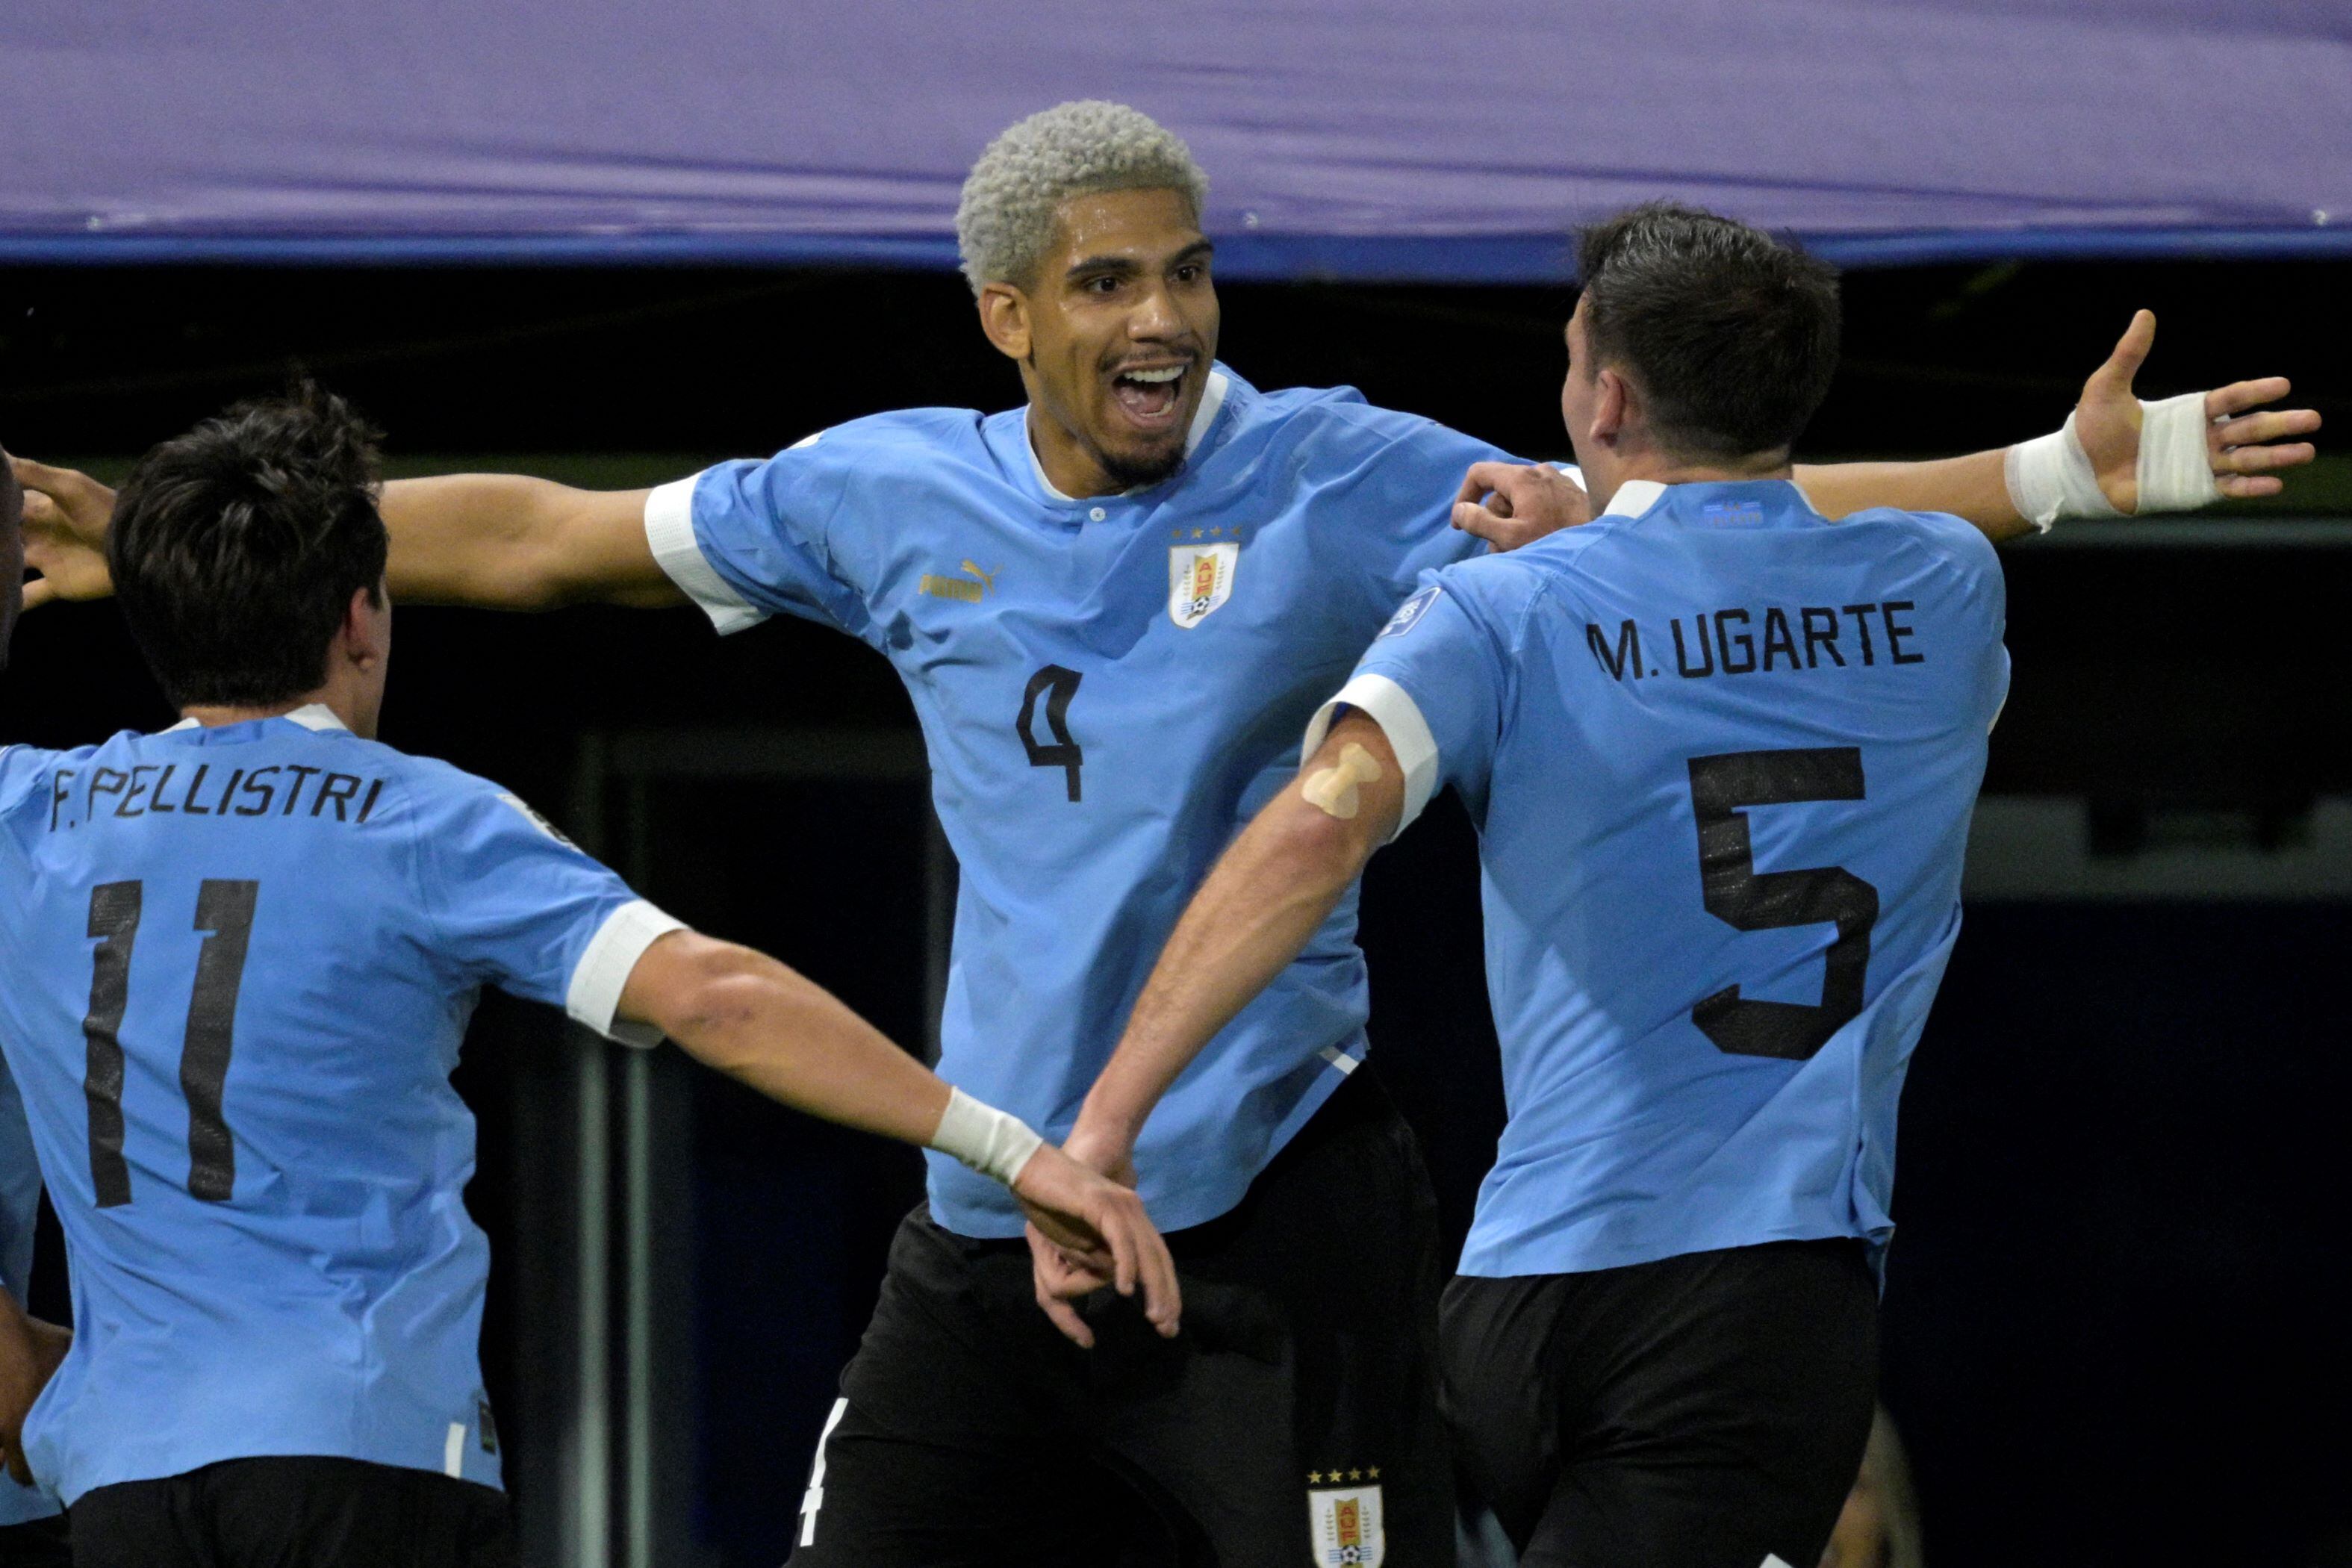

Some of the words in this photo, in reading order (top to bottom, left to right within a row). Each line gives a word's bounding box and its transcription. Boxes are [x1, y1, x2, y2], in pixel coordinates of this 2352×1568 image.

[1585, 618, 1659, 681] M.
[1670, 601, 1925, 679] UGARTE
[49, 768, 75, 832] F.
[87, 764, 384, 823] PELLISTRI
[1015, 663, 1083, 803] 4
[1687, 747, 1879, 1062] 5
[82, 878, 260, 1208] 11
